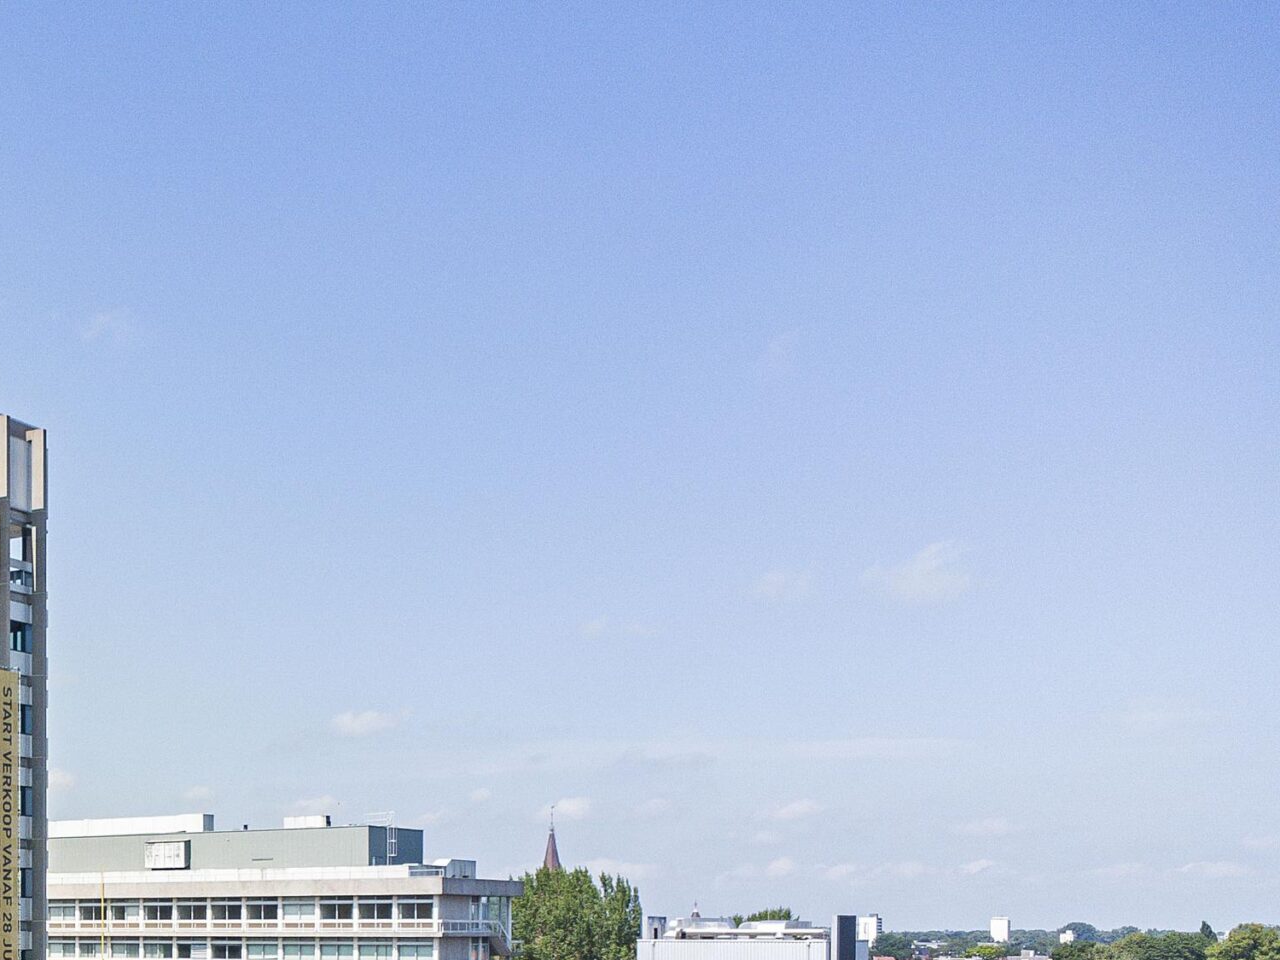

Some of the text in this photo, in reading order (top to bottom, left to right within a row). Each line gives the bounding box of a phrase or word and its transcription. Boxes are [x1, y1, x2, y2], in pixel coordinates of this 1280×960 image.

[2, 686, 13, 746] START
[2, 751, 13, 838] VERKOOP
[2, 844, 13, 907] VANAF
[2, 912, 13, 933] 28
